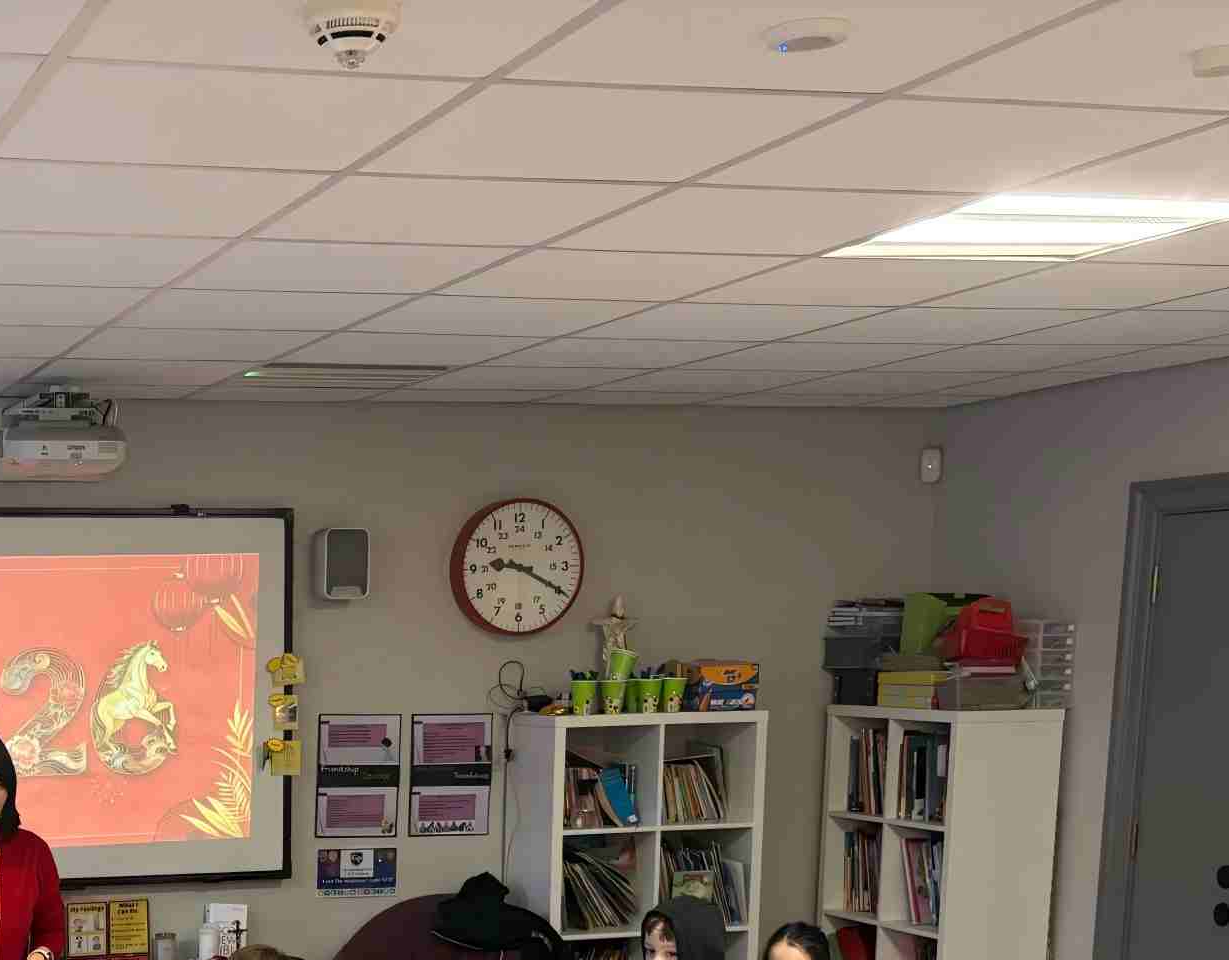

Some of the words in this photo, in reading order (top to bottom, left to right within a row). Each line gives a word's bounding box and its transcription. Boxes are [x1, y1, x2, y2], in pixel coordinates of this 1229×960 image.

[514, 512, 526, 523] 12
[493, 519, 502, 531] 11
[476, 538, 488, 548] 10
[555, 536, 563, 546] 2
[470, 564, 477, 574] 9
[561, 561, 569, 571] 3
[476, 588, 483, 599] 8
[494, 607, 501, 616] 7
[539, 604, 545, 615] 5
[514, 612, 522, 622] 6
